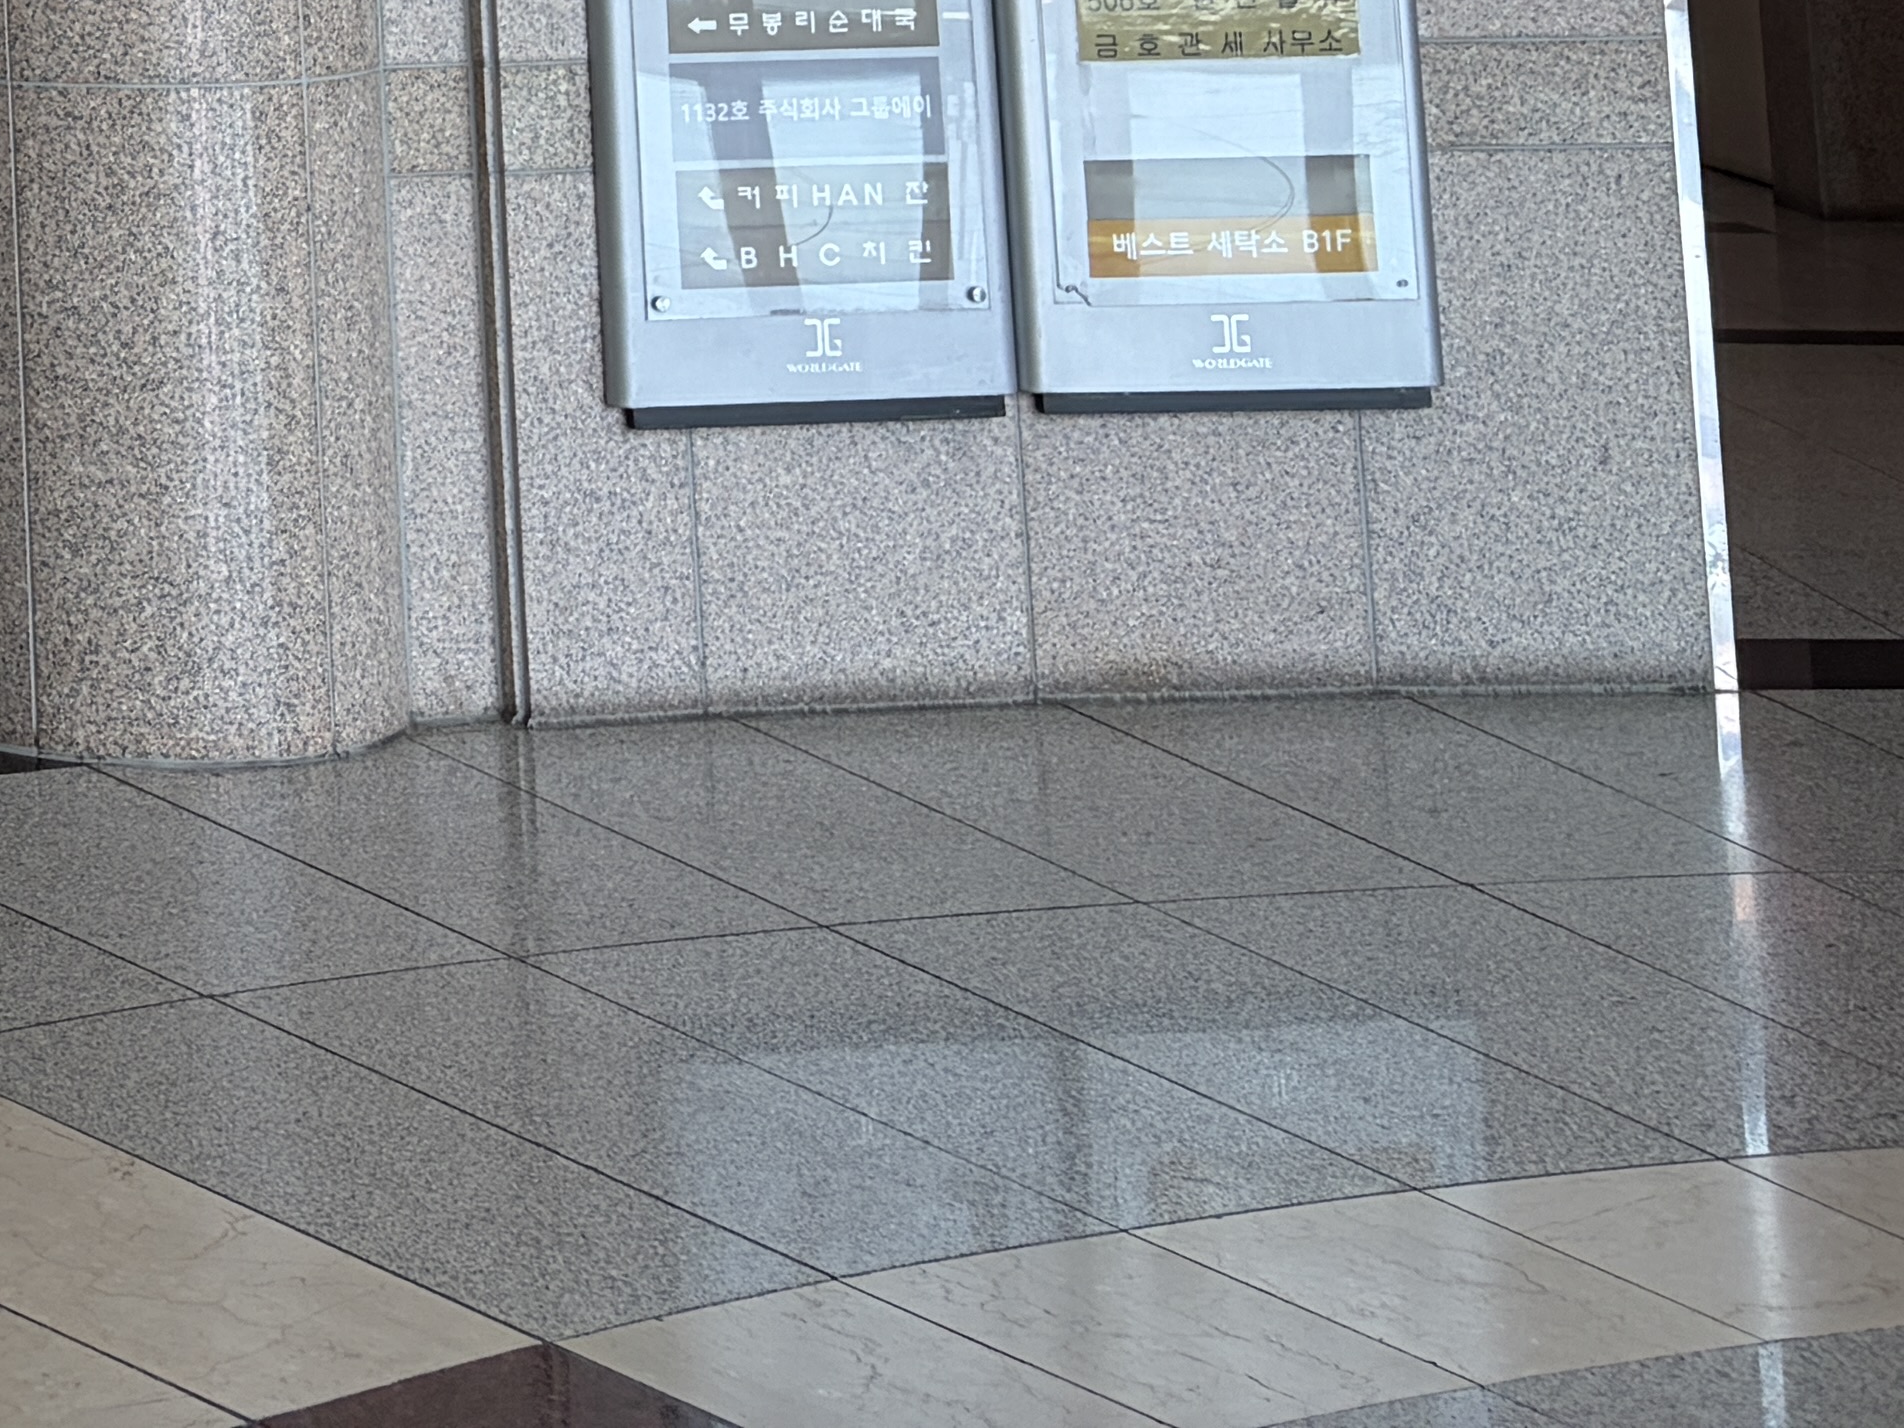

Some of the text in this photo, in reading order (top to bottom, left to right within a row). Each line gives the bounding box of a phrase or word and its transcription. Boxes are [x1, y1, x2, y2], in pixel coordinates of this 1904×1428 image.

[1264, 28, 1344, 56] 사무소
[680, 100, 750, 124] 1132호
[758, 97, 841, 122] 주식회사
[1111, 228, 1352, 261] 베스트 세탁소 B1F
